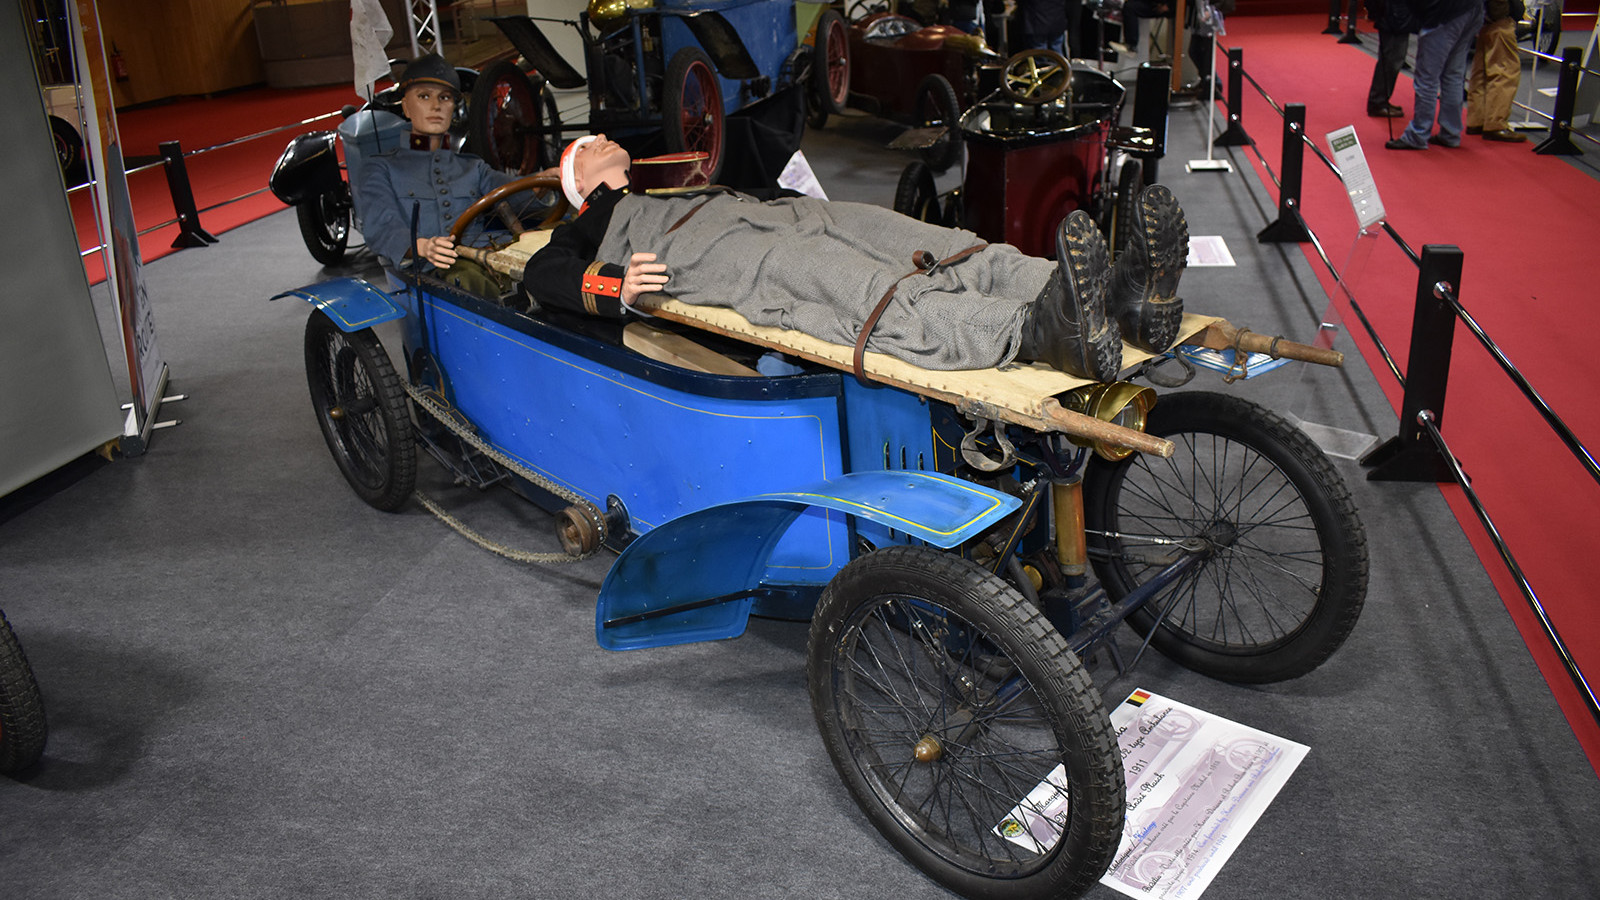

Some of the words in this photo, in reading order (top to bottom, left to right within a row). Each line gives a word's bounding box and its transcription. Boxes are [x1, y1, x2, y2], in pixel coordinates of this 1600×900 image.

[1127, 736, 1145, 748] type
[1138, 707, 1172, 735] Ambulance
[1128, 759, 1148, 775] 1911
[1126, 792, 1146, 811] André
[1140, 831, 1160, 853] ambulance
[1174, 791, 1195, 810] Capitaine
[1193, 838, 1208, 848] Car
[1203, 822, 1223, 841] founded
[1108, 848, 1134, 875] Historique
[1132, 821, 1156, 842] History
[1141, 875, 1161, 893] Bédélia
